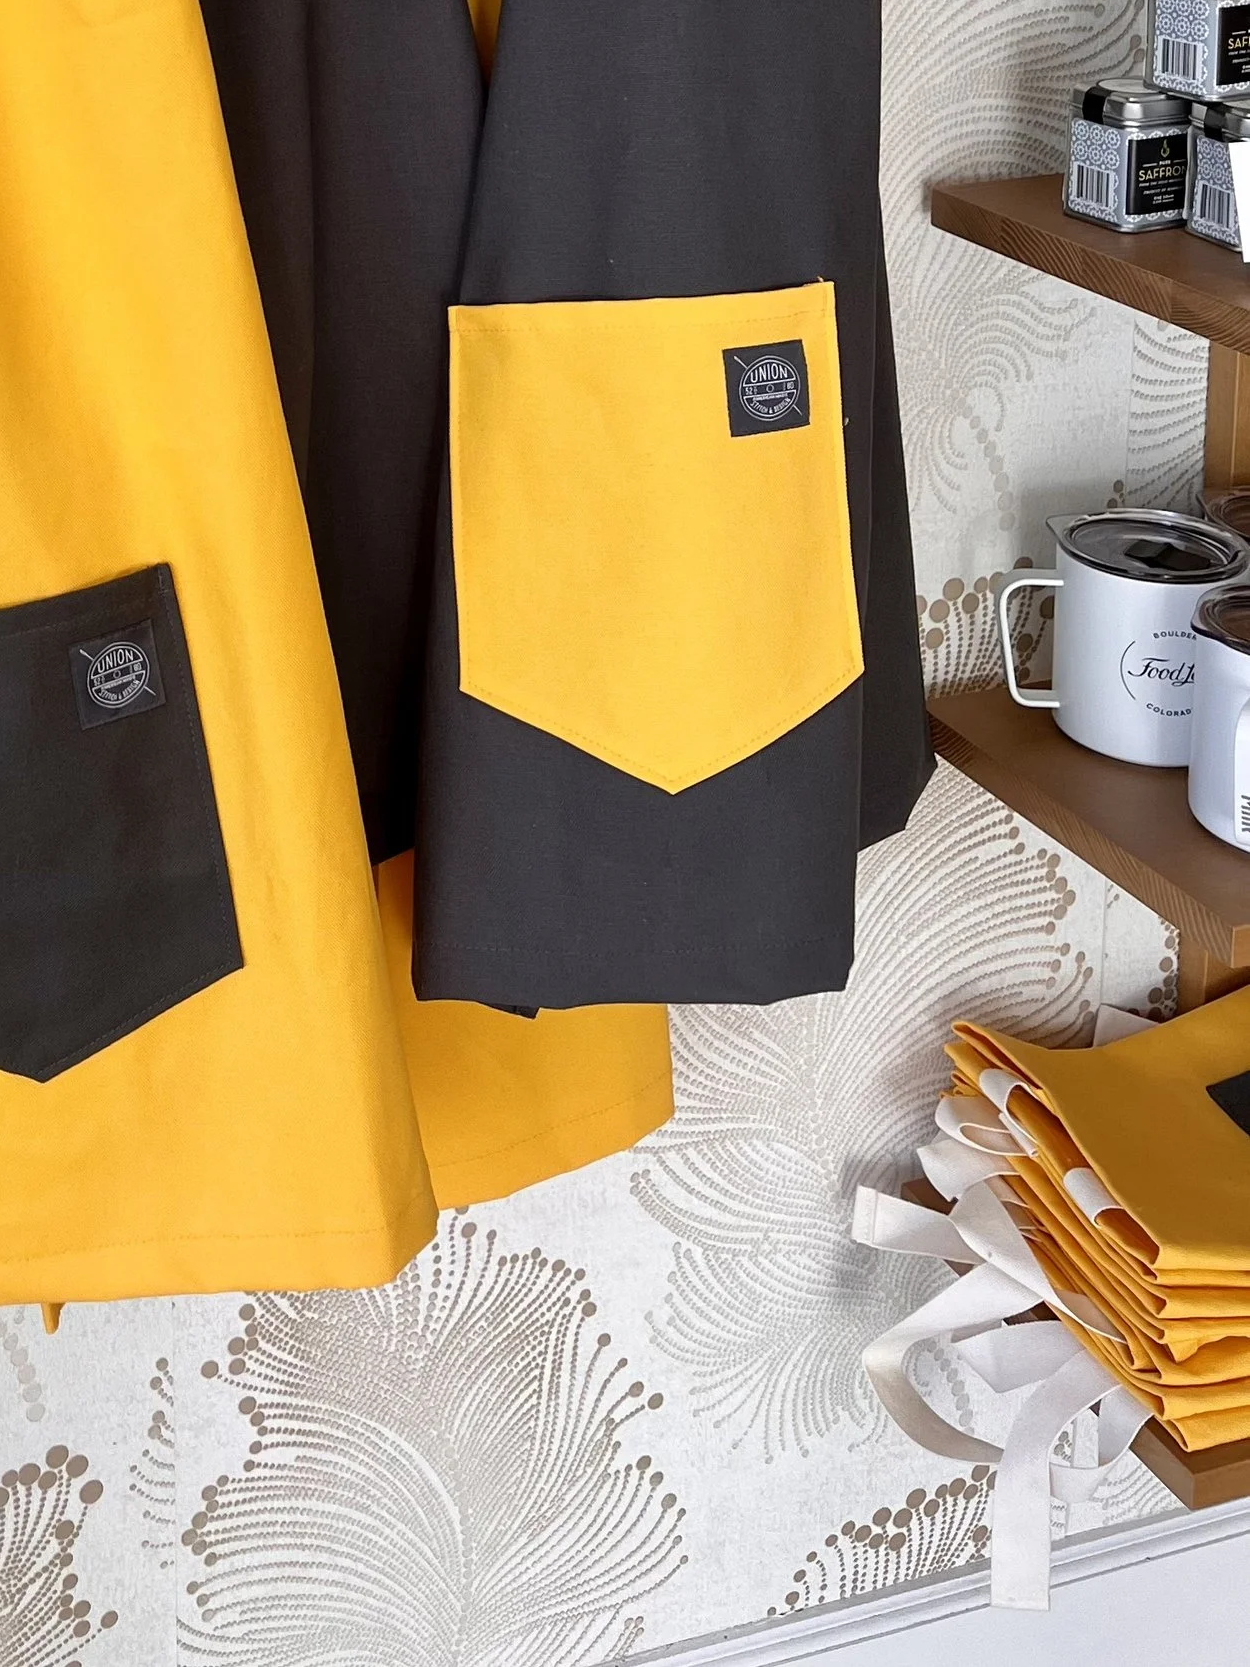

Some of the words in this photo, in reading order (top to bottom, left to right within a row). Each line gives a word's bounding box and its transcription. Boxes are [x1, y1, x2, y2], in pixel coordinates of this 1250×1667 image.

[750, 363, 788, 383] UNION
[97, 648, 134, 673] UNION
[1146, 703, 1192, 717] COLORAD
